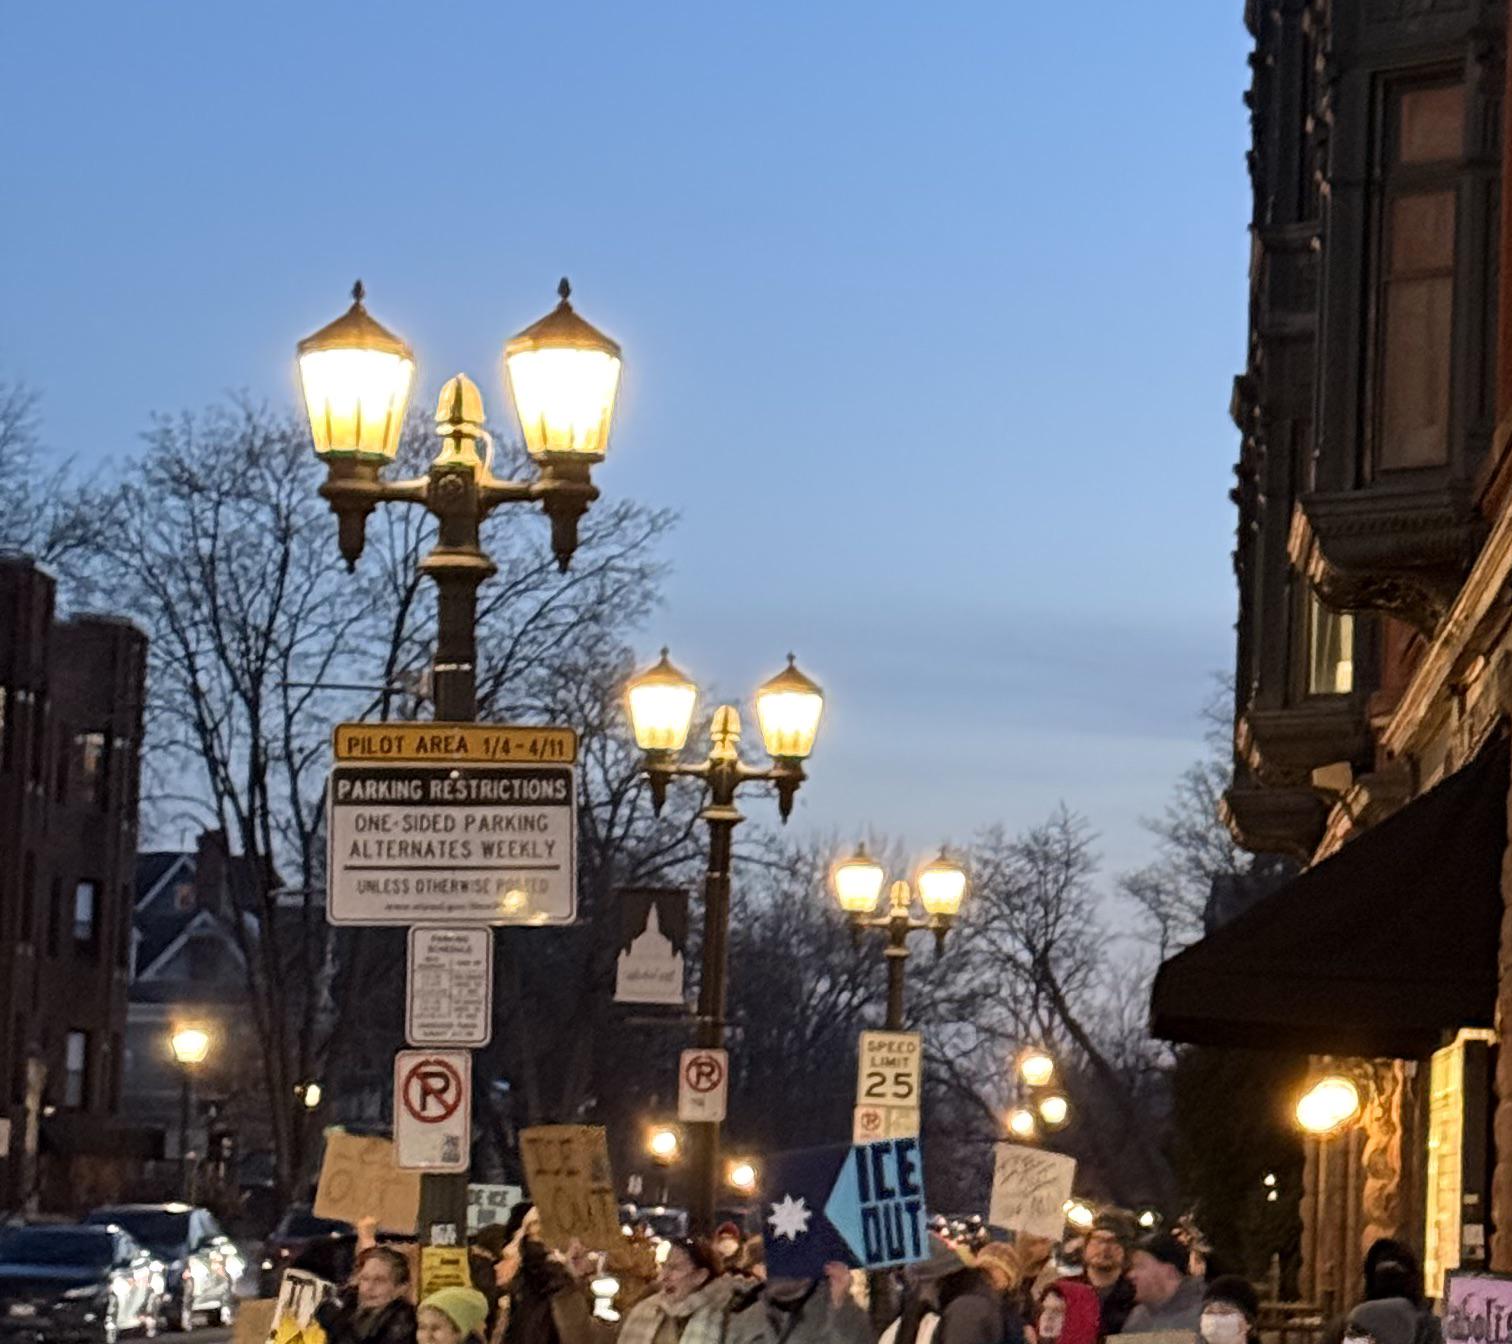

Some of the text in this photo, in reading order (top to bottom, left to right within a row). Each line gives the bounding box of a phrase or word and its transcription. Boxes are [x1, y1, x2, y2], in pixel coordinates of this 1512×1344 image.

[348, 736, 405, 755] PILOT
[416, 736, 469, 754] AREA
[338, 778, 567, 801] PARKING RESTRICTIONS
[355, 813, 549, 833] ONE-SIDED PARKING
[349, 839, 556, 859] ALTERNATES WEEKLY
[357, 877, 410, 895] UNLESS
[415, 877, 492, 895] OTHERWISE
[866, 1039, 916, 1054] SPEED
[869, 1056, 910, 1069] LIMIT
[863, 1071, 914, 1099] 25
[855, 1137, 921, 1203] ICE
[862, 1200, 923, 1263] OUT
